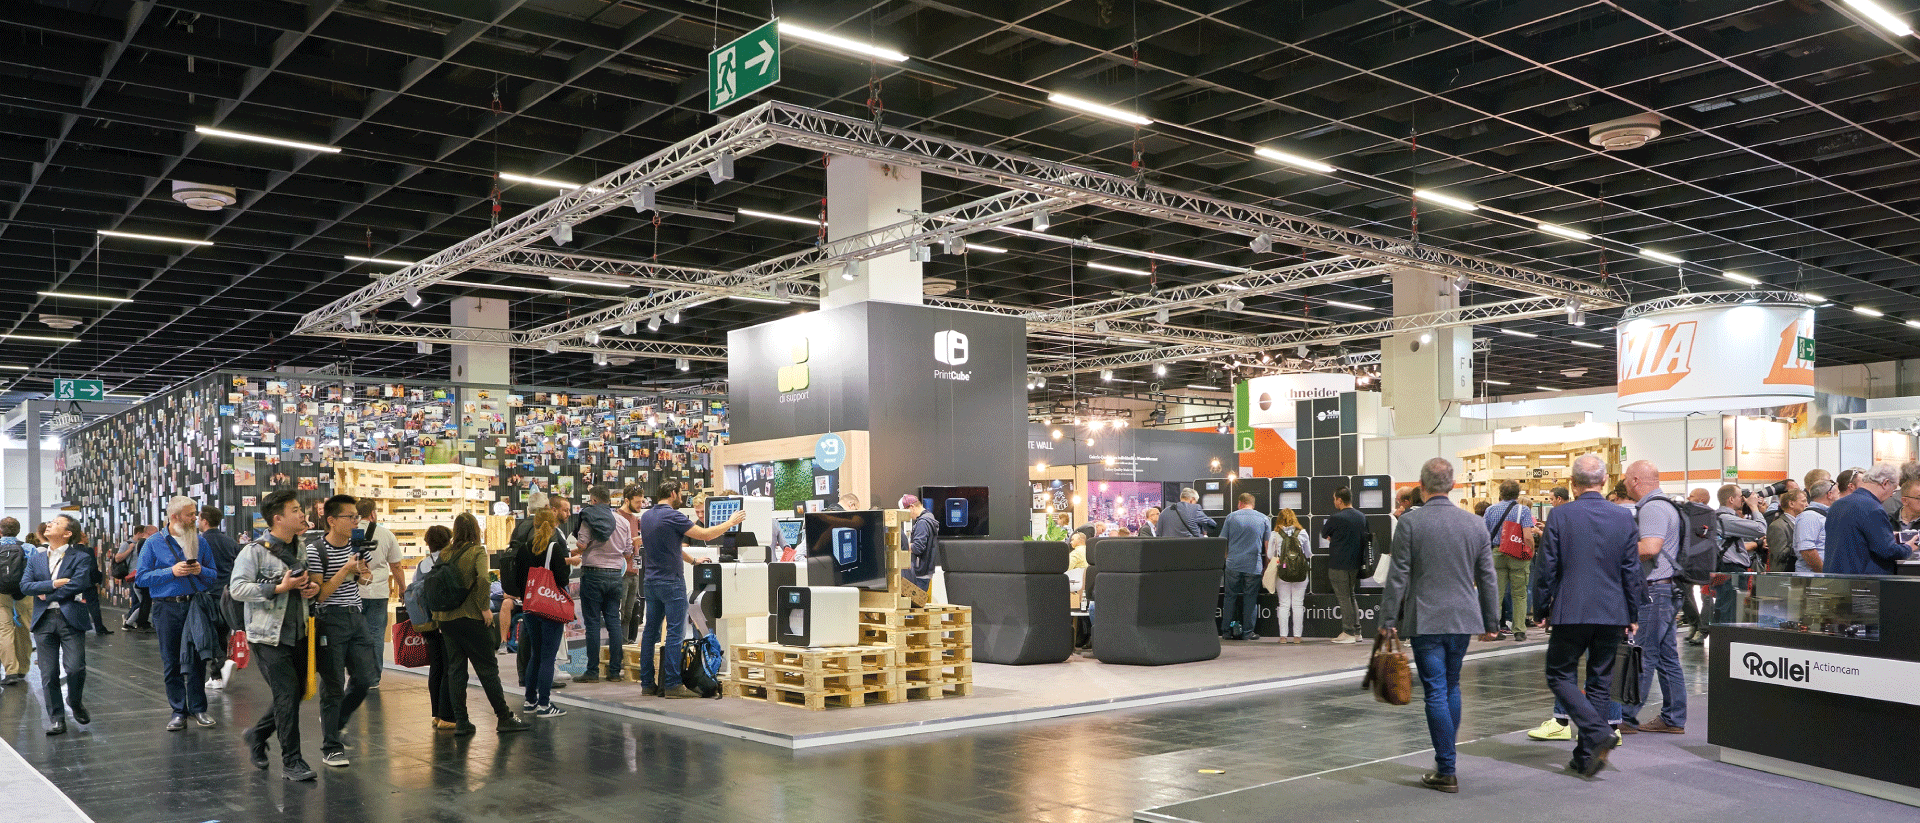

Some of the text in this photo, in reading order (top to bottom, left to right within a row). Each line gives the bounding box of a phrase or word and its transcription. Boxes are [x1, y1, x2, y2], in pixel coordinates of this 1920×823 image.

[1617, 321, 1698, 388] MIA
[1460, 357, 1466, 387] F 6
[779, 391, 809, 403] di support
[1286, 387, 1338, 399] hneider
[1036, 441, 1054, 449] WALL
[1243, 437, 1253, 450] D
[1510, 534, 1523, 545] ce
[537, 586, 567, 603] cewe
[1302, 604, 1381, 620] rintCe®
[1743, 651, 1860, 682] Rollei Actioncam
